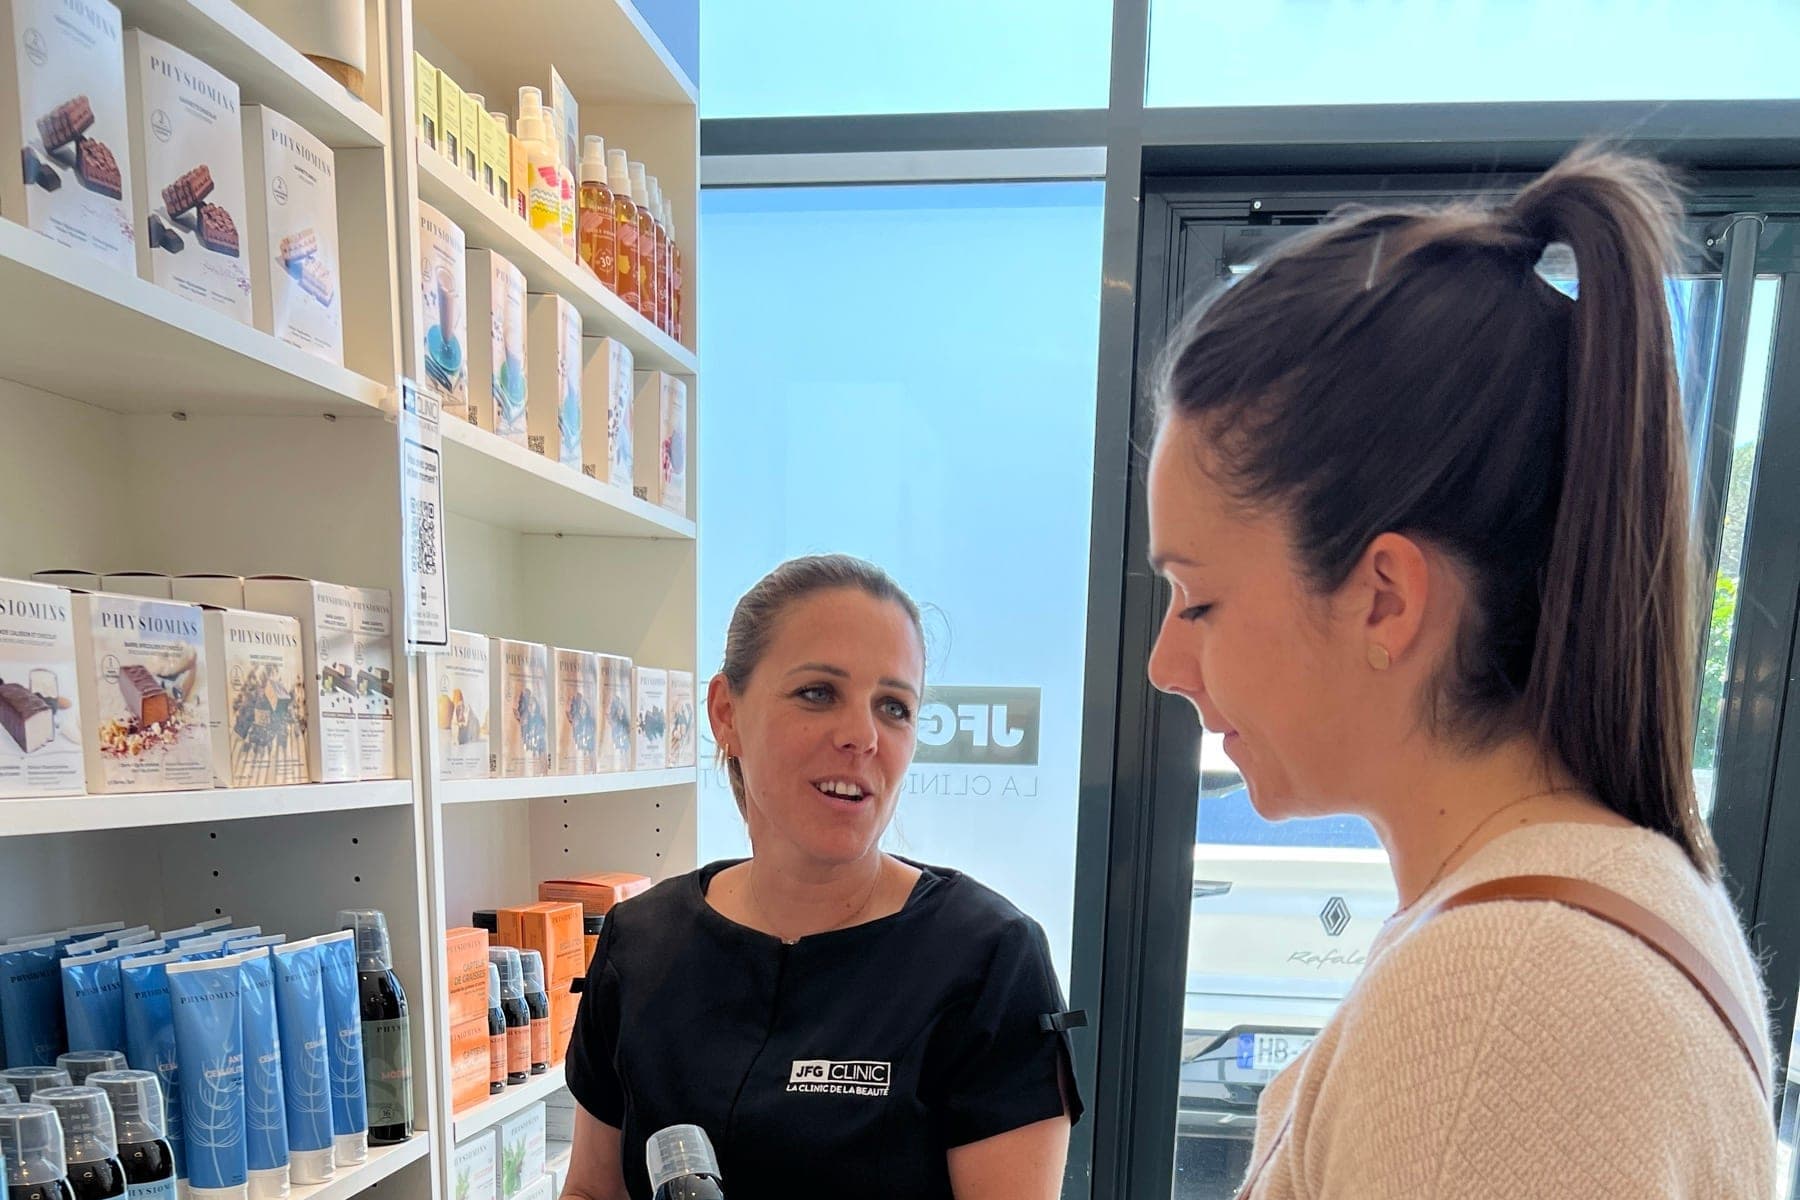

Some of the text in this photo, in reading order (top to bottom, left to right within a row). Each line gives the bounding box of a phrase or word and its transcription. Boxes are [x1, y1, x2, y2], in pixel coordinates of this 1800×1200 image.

[150, 55, 235, 113] PHYSIOMINS
[271, 128, 332, 177] PHYSIOMINS
[102, 612, 198, 637] PHYSIOMINS
[230, 628, 297, 647] PHYSIOMINS
[1258, 1037, 1313, 1064] HB-
[796, 1064, 885, 1081] JFG CLINIC
[786, 1084, 889, 1097] LA CLINIC DE LA BEAUTÉ
